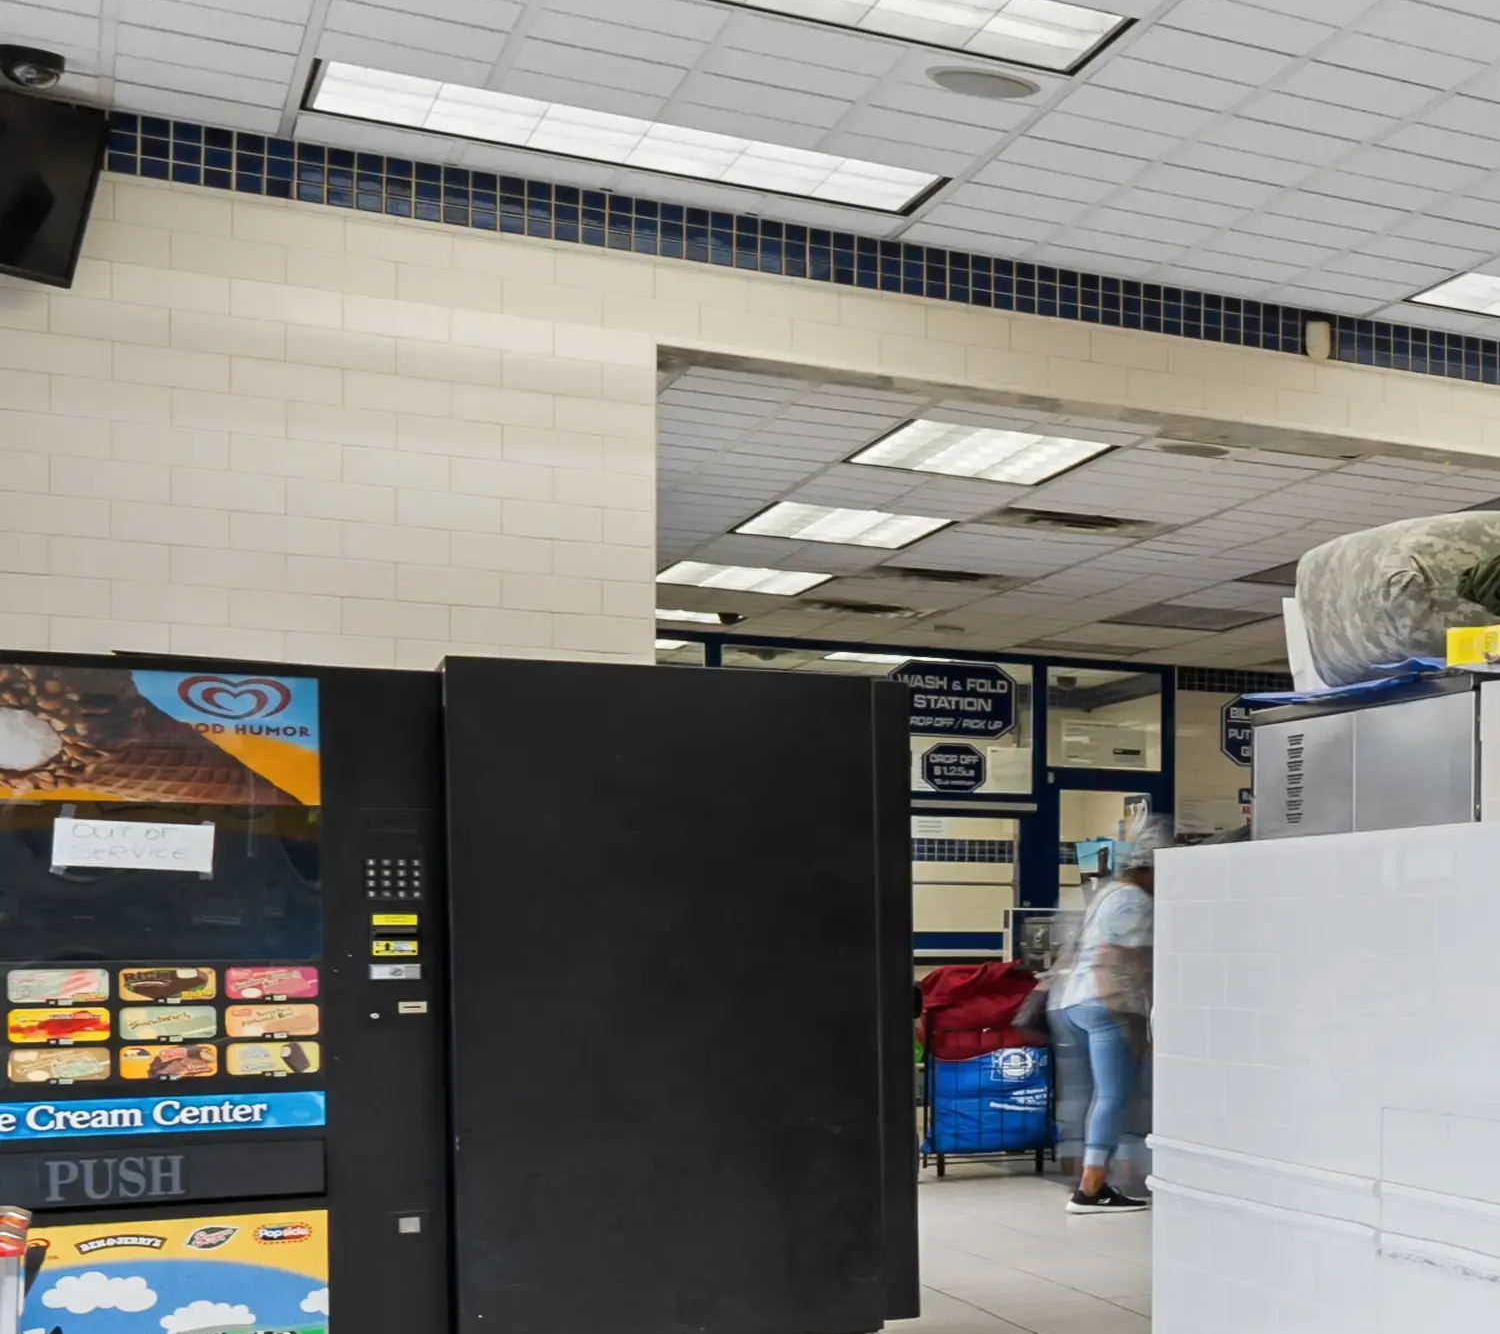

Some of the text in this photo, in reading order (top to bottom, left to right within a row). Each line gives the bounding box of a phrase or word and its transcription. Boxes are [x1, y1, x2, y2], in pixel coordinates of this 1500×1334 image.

[896, 673, 1008, 694] WASH & FOLD
[913, 694, 992, 712] STATION
[910, 715, 934, 727] ROP
[235, 723, 311, 737] HUMOR
[929, 754, 958, 764] DROP
[144, 827, 178, 840] OF
[69, 843, 189, 860] SERVICE
[25, 1104, 144, 1132] Cream
[152, 1099, 268, 1126] Center
[44, 1155, 186, 1203] PUSH
